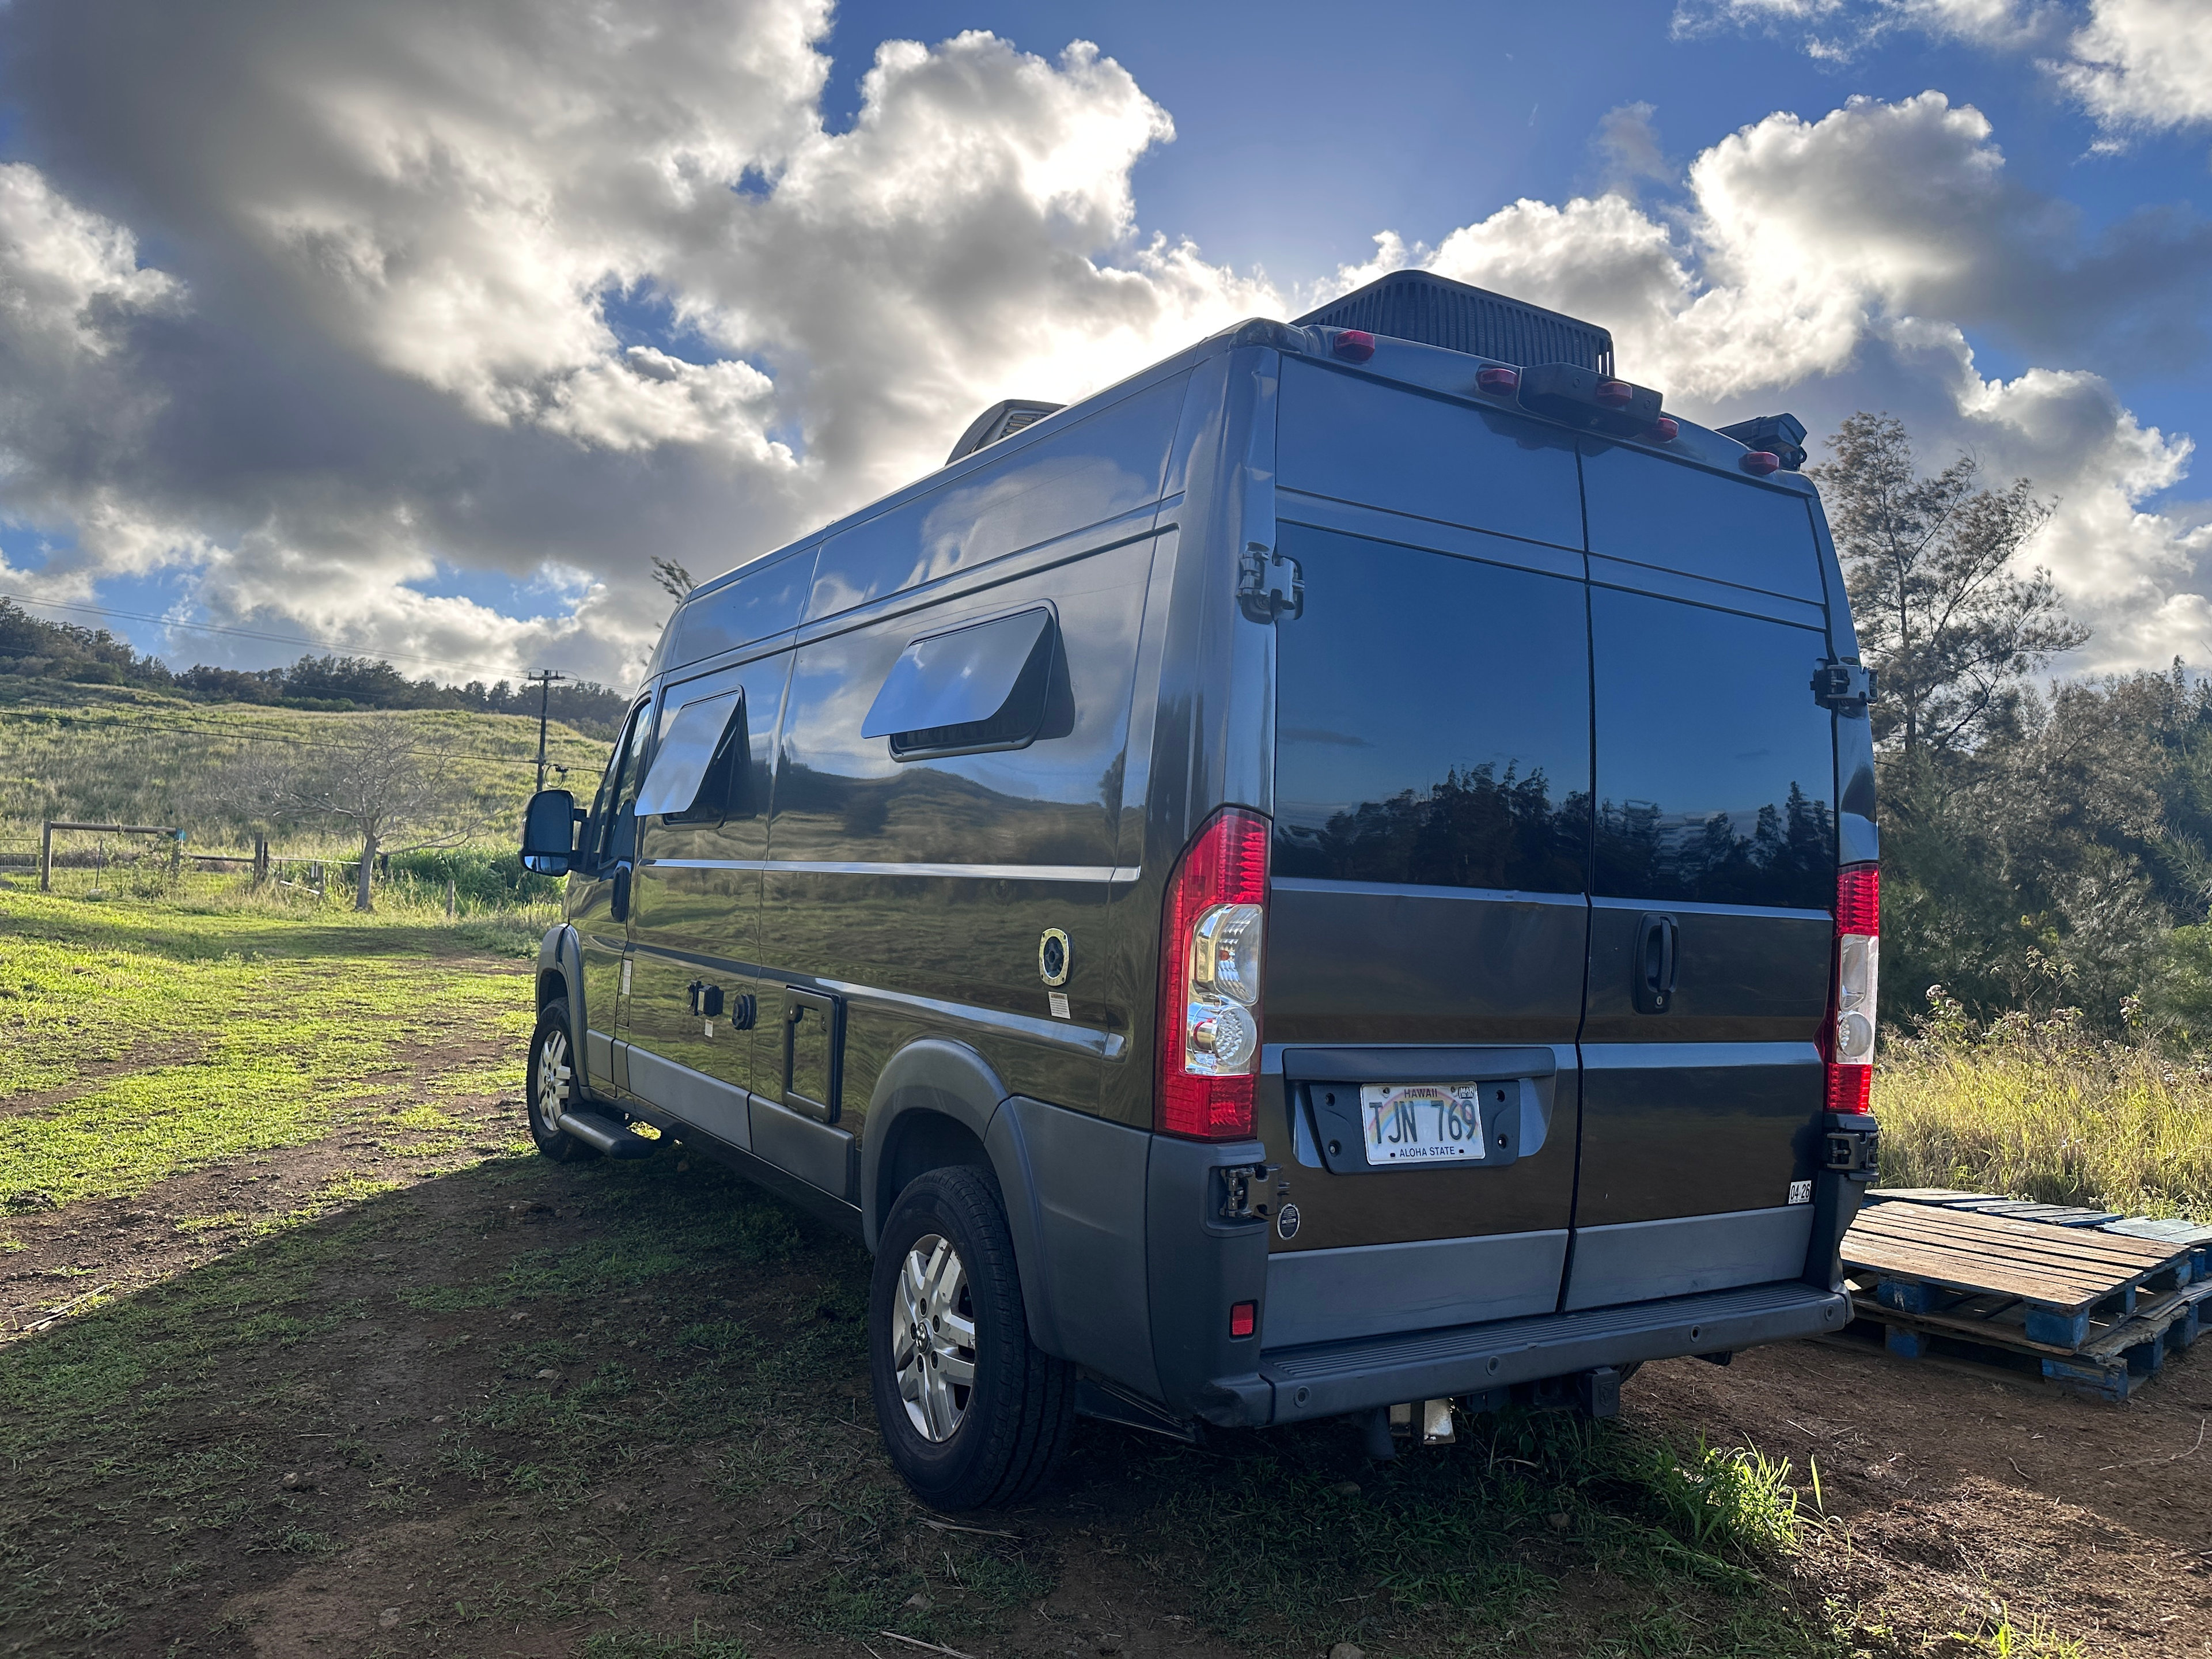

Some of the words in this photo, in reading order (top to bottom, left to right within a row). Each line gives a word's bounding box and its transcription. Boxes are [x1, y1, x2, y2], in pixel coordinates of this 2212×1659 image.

[1404, 1089, 1437, 1098] HAWAII
[1369, 1101, 1418, 1143] TJN
[1431, 1100, 1475, 1141] 769
[1400, 1148, 1427, 1157] ALOHA
[1429, 1146, 1455, 1156] STATE
[1791, 1185, 1799, 1199] 04
[1801, 1184, 1810, 1198] 26
